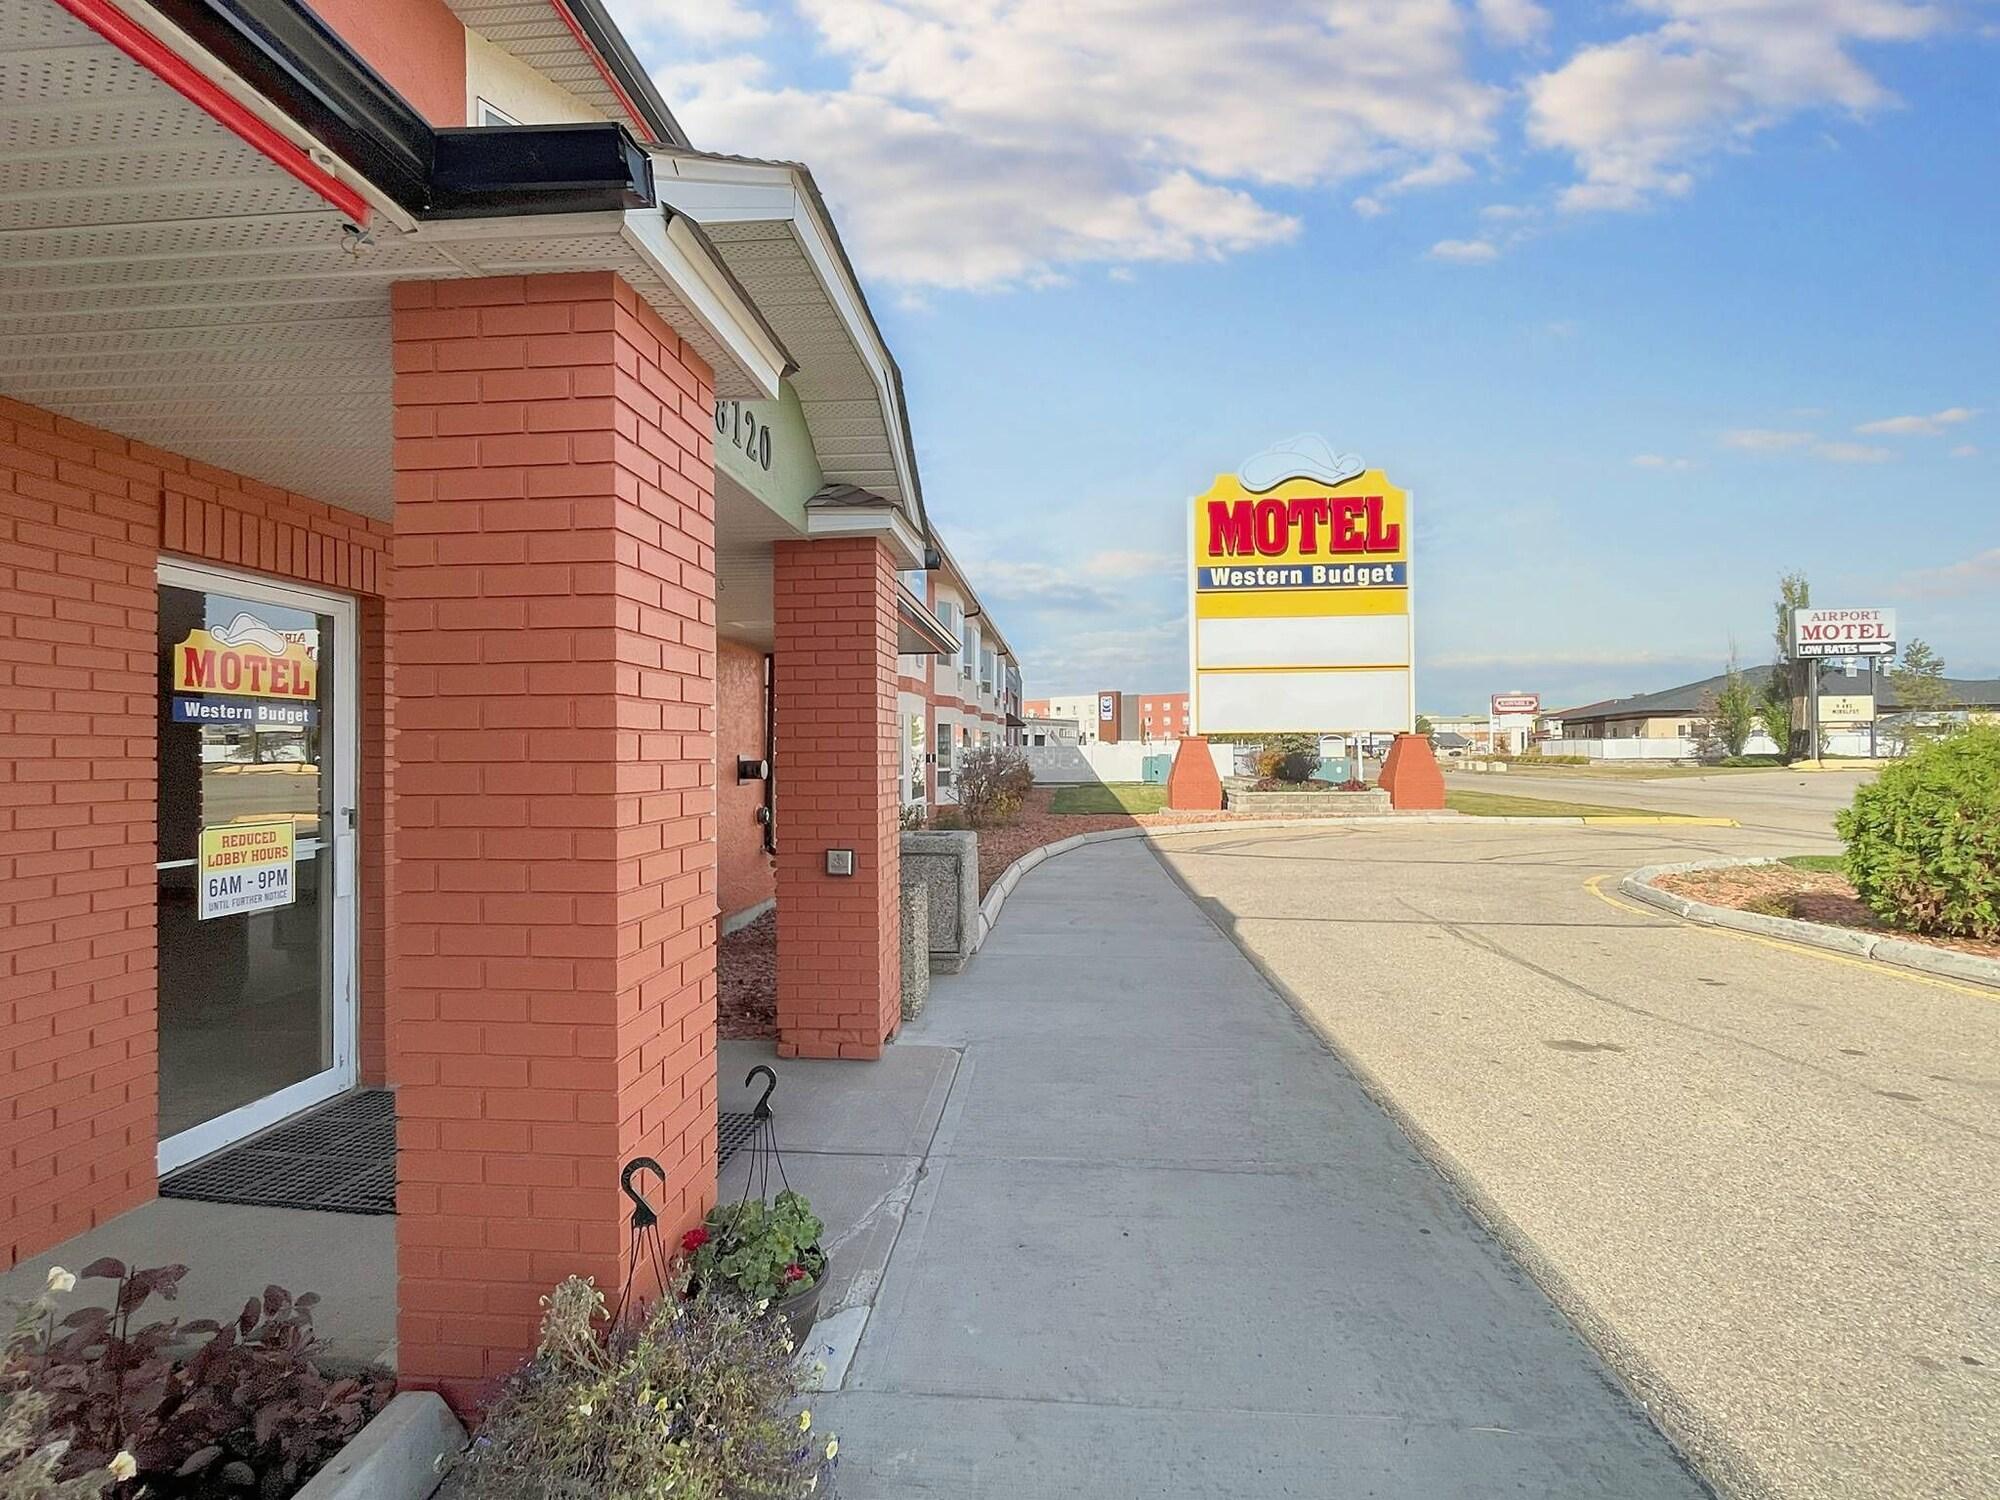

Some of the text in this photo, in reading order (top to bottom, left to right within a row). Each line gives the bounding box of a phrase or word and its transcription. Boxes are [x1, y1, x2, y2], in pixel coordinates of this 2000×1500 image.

[1208, 496, 1400, 557] MOTEL
[1210, 564, 1394, 586] Western Budget
[1811, 611, 1880, 621] AIRPORT
[1801, 624, 1891, 640] MOTEL
[1800, 644, 1858, 654] LOW RATES
[184, 647, 310, 696] MOTEL
[184, 702, 309, 724] Western Budget
[222, 831, 277, 848] REDUCED
[208, 846, 289, 867] LOBBY HOURS
[209, 875, 242, 897] 6AM
[258, 868, 288, 889] 9PM
[208, 889, 288, 912] UNTIL FURTHER NOTICE
